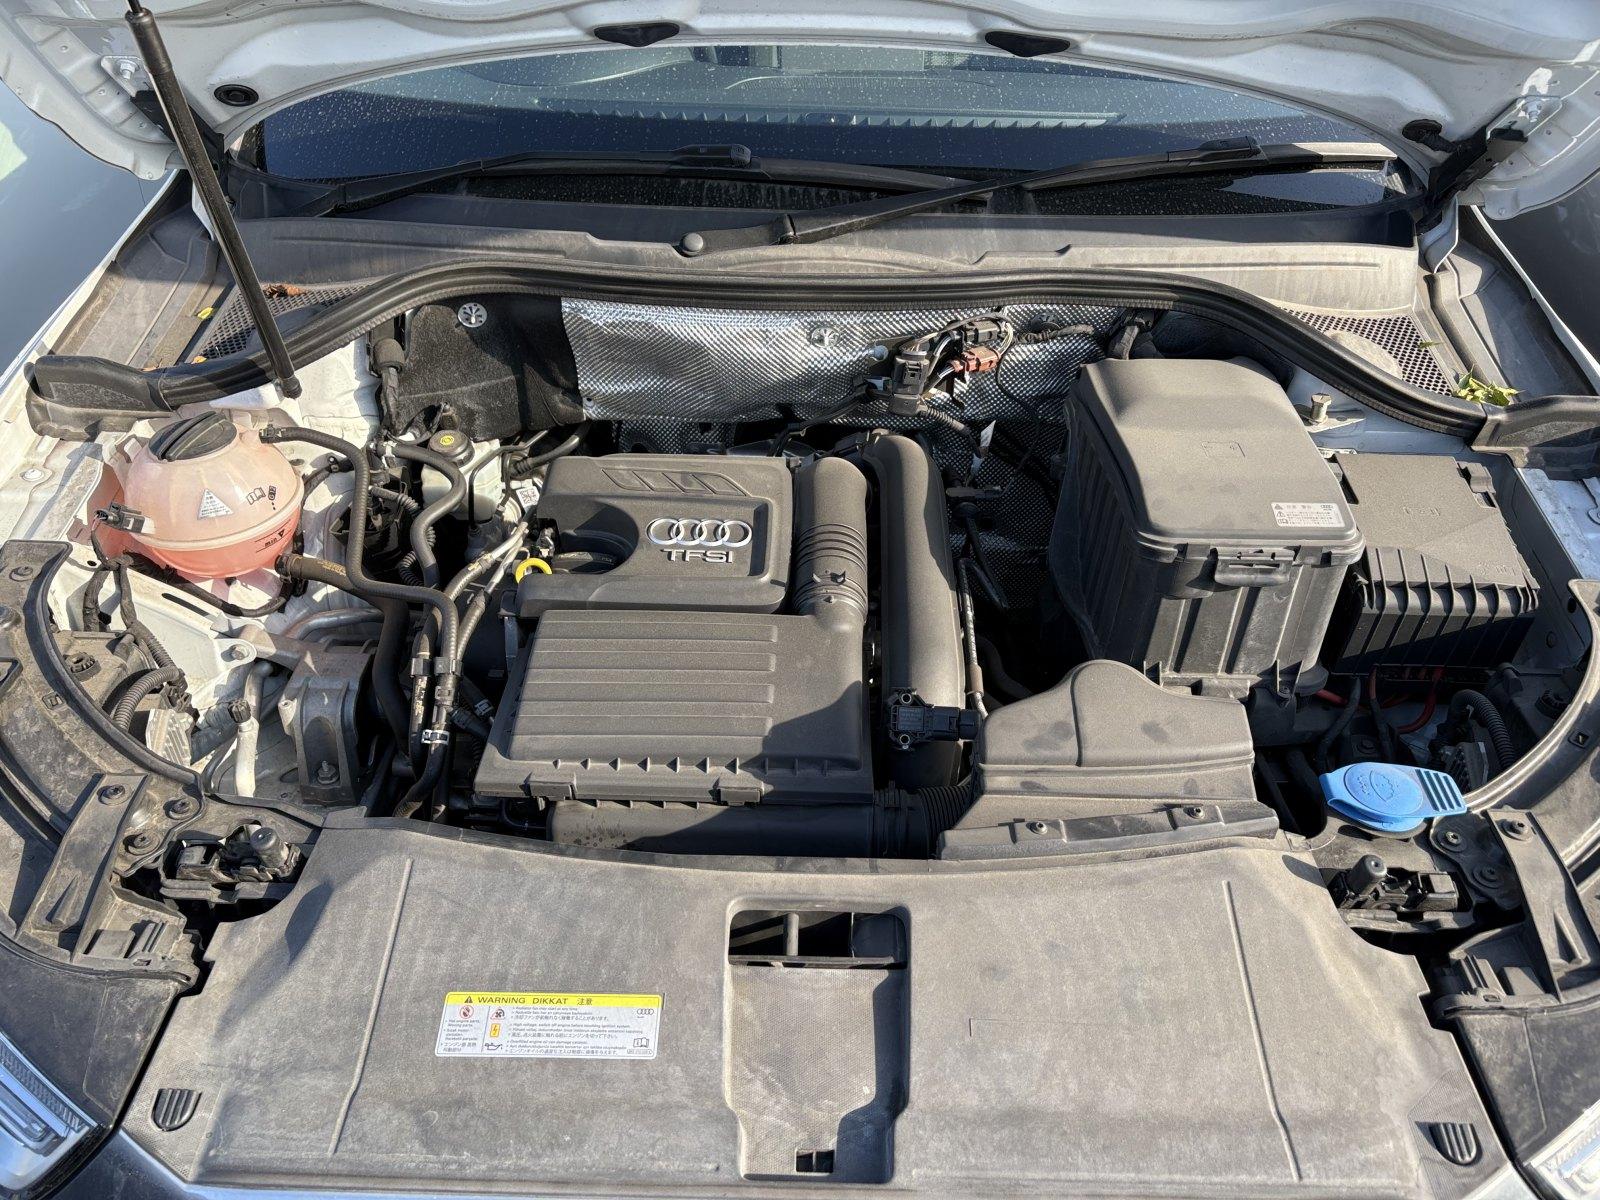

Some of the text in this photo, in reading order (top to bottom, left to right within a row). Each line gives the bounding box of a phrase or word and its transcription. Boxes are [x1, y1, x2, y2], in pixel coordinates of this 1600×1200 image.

[662, 548, 733, 563] TFSI
[477, 996, 569, 1005] WARNING DIKKAT
